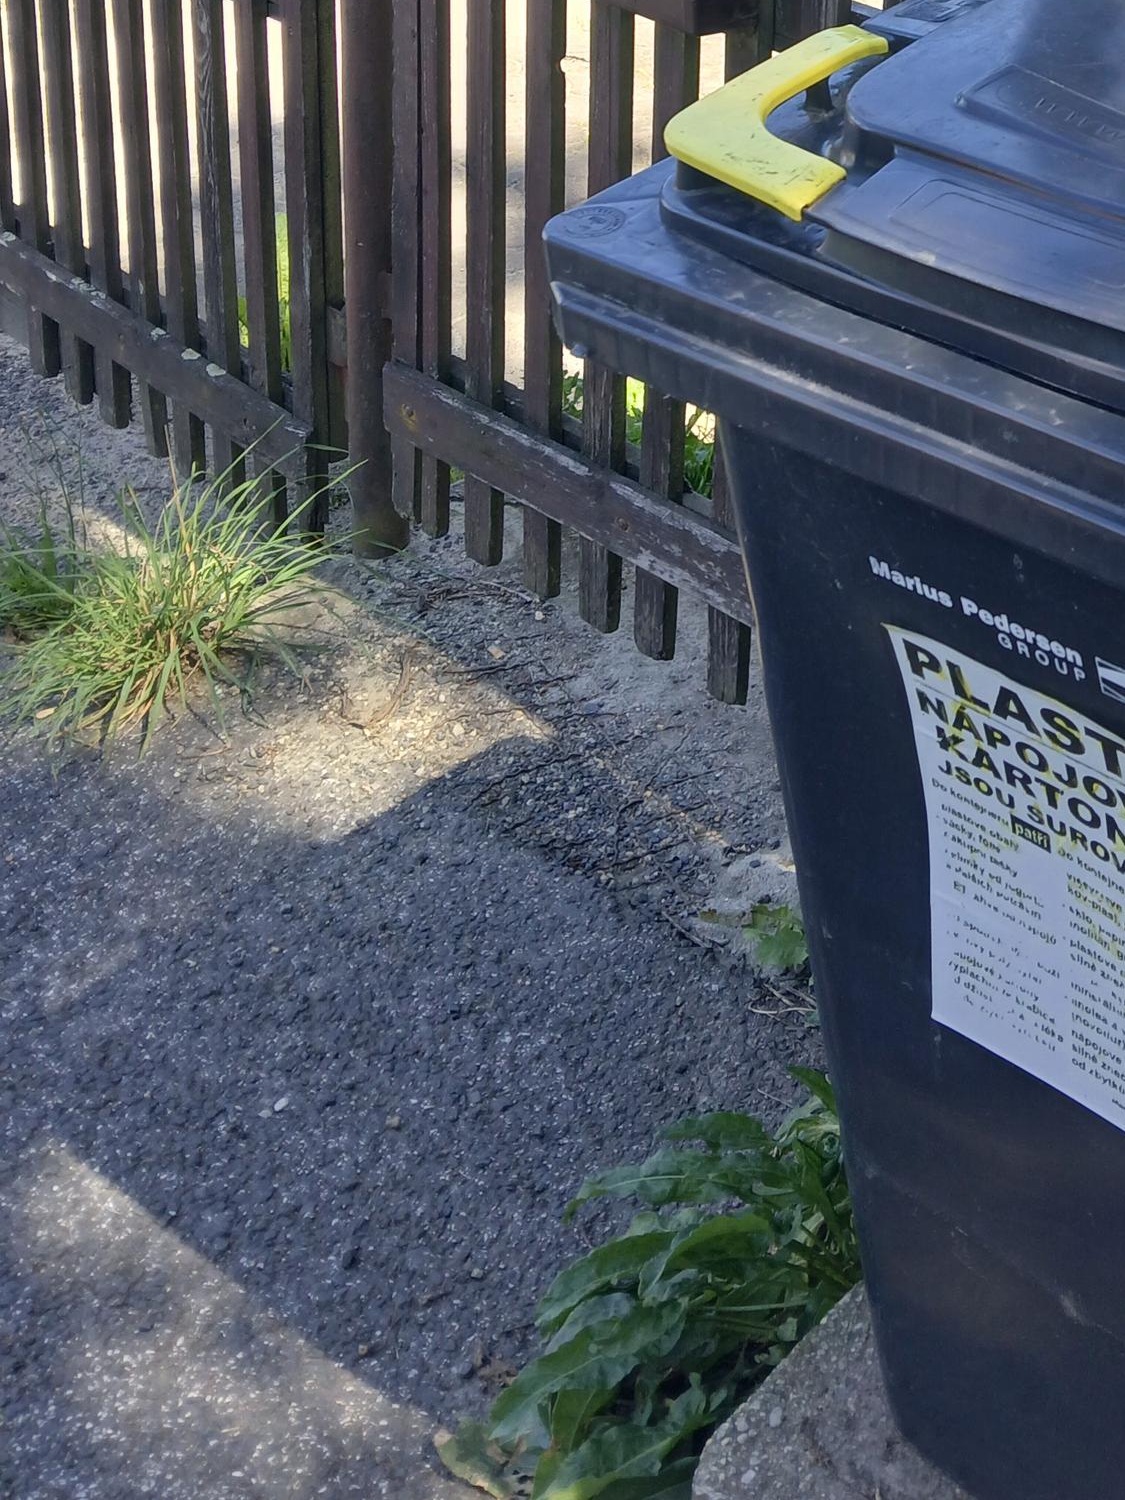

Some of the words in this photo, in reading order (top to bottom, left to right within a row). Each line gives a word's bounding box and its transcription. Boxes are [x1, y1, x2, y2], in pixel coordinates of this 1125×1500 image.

[868, 555, 953, 608] Marius
[959, 595, 1084, 667] Pedersen
[997, 632, 1087, 682] GROUP
[938, 760, 1015, 809] JSOU
[1015, 823, 1050, 850] patří
